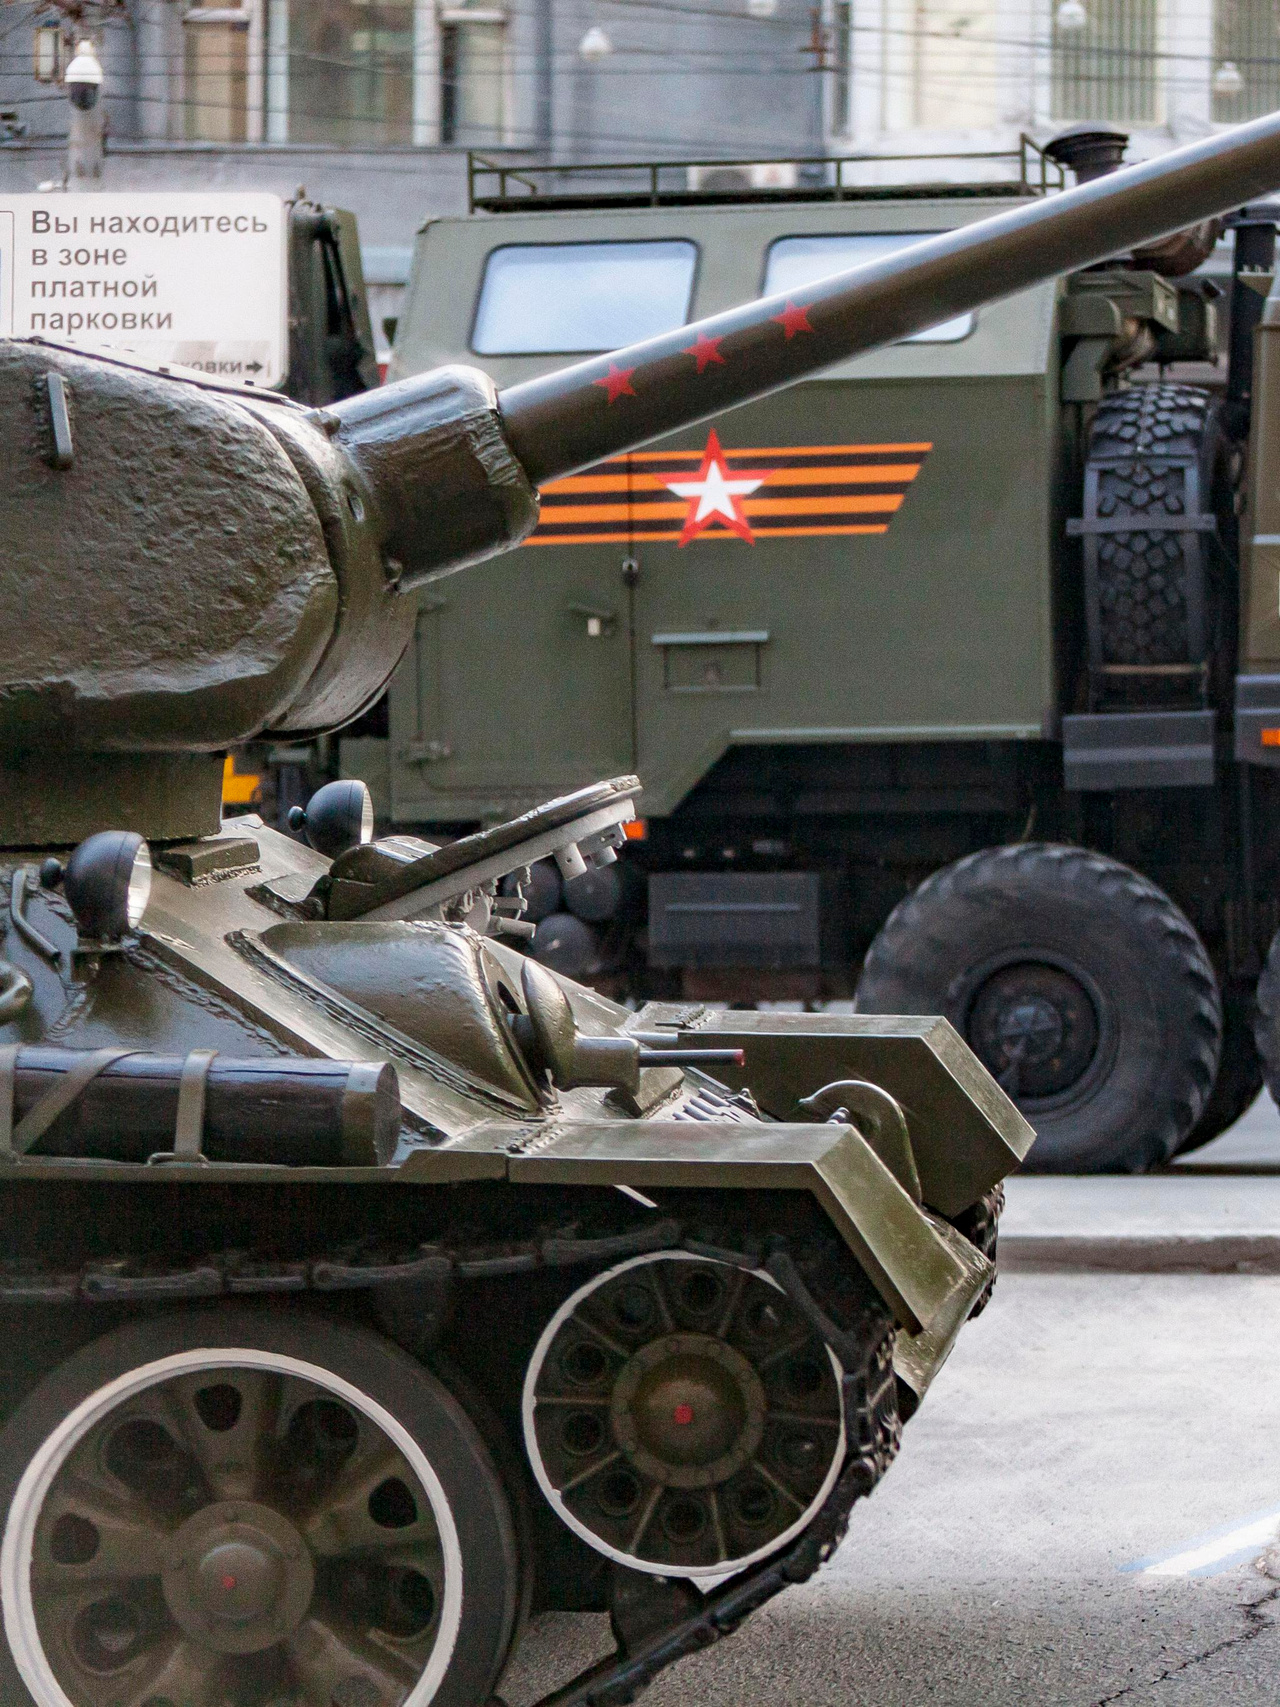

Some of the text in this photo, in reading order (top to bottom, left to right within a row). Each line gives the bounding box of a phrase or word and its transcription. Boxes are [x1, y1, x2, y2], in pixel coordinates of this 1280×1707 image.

[32, 210, 268, 237] Вы находитесь
[31, 248, 128, 266] в зоне
[31, 274, 158, 298] платной
[30, 312, 174, 336] парковки
